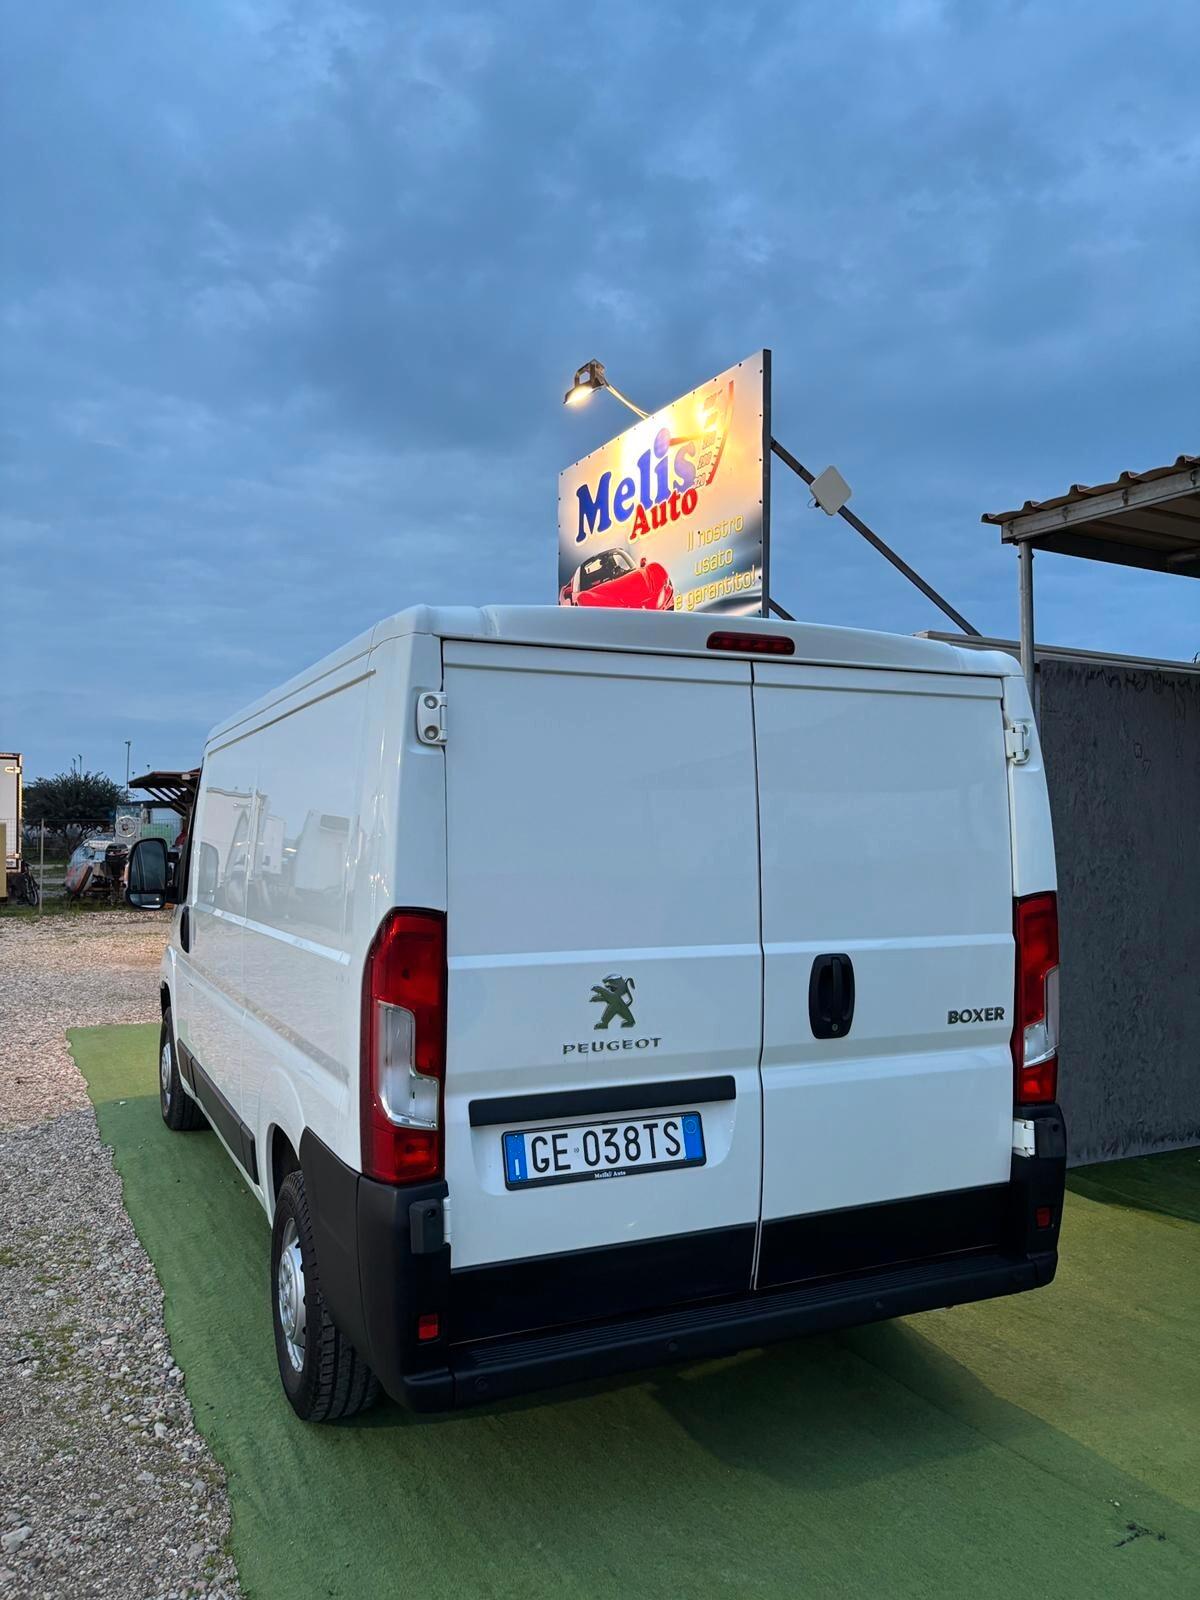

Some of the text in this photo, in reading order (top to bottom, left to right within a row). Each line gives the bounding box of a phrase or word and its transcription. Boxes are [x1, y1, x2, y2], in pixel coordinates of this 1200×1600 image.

[575, 428, 697, 543] Melis
[629, 488, 698, 541] Auto
[687, 514, 743, 552] Il nostro
[694, 548, 733, 576] usato
[685, 564, 756, 611] garantito!
[947, 1006, 1005, 1025] BOXER
[562, 1037, 662, 1055] PEUGEOT
[531, 1133, 571, 1173] GE
[582, 1121, 682, 1167] 038TS
